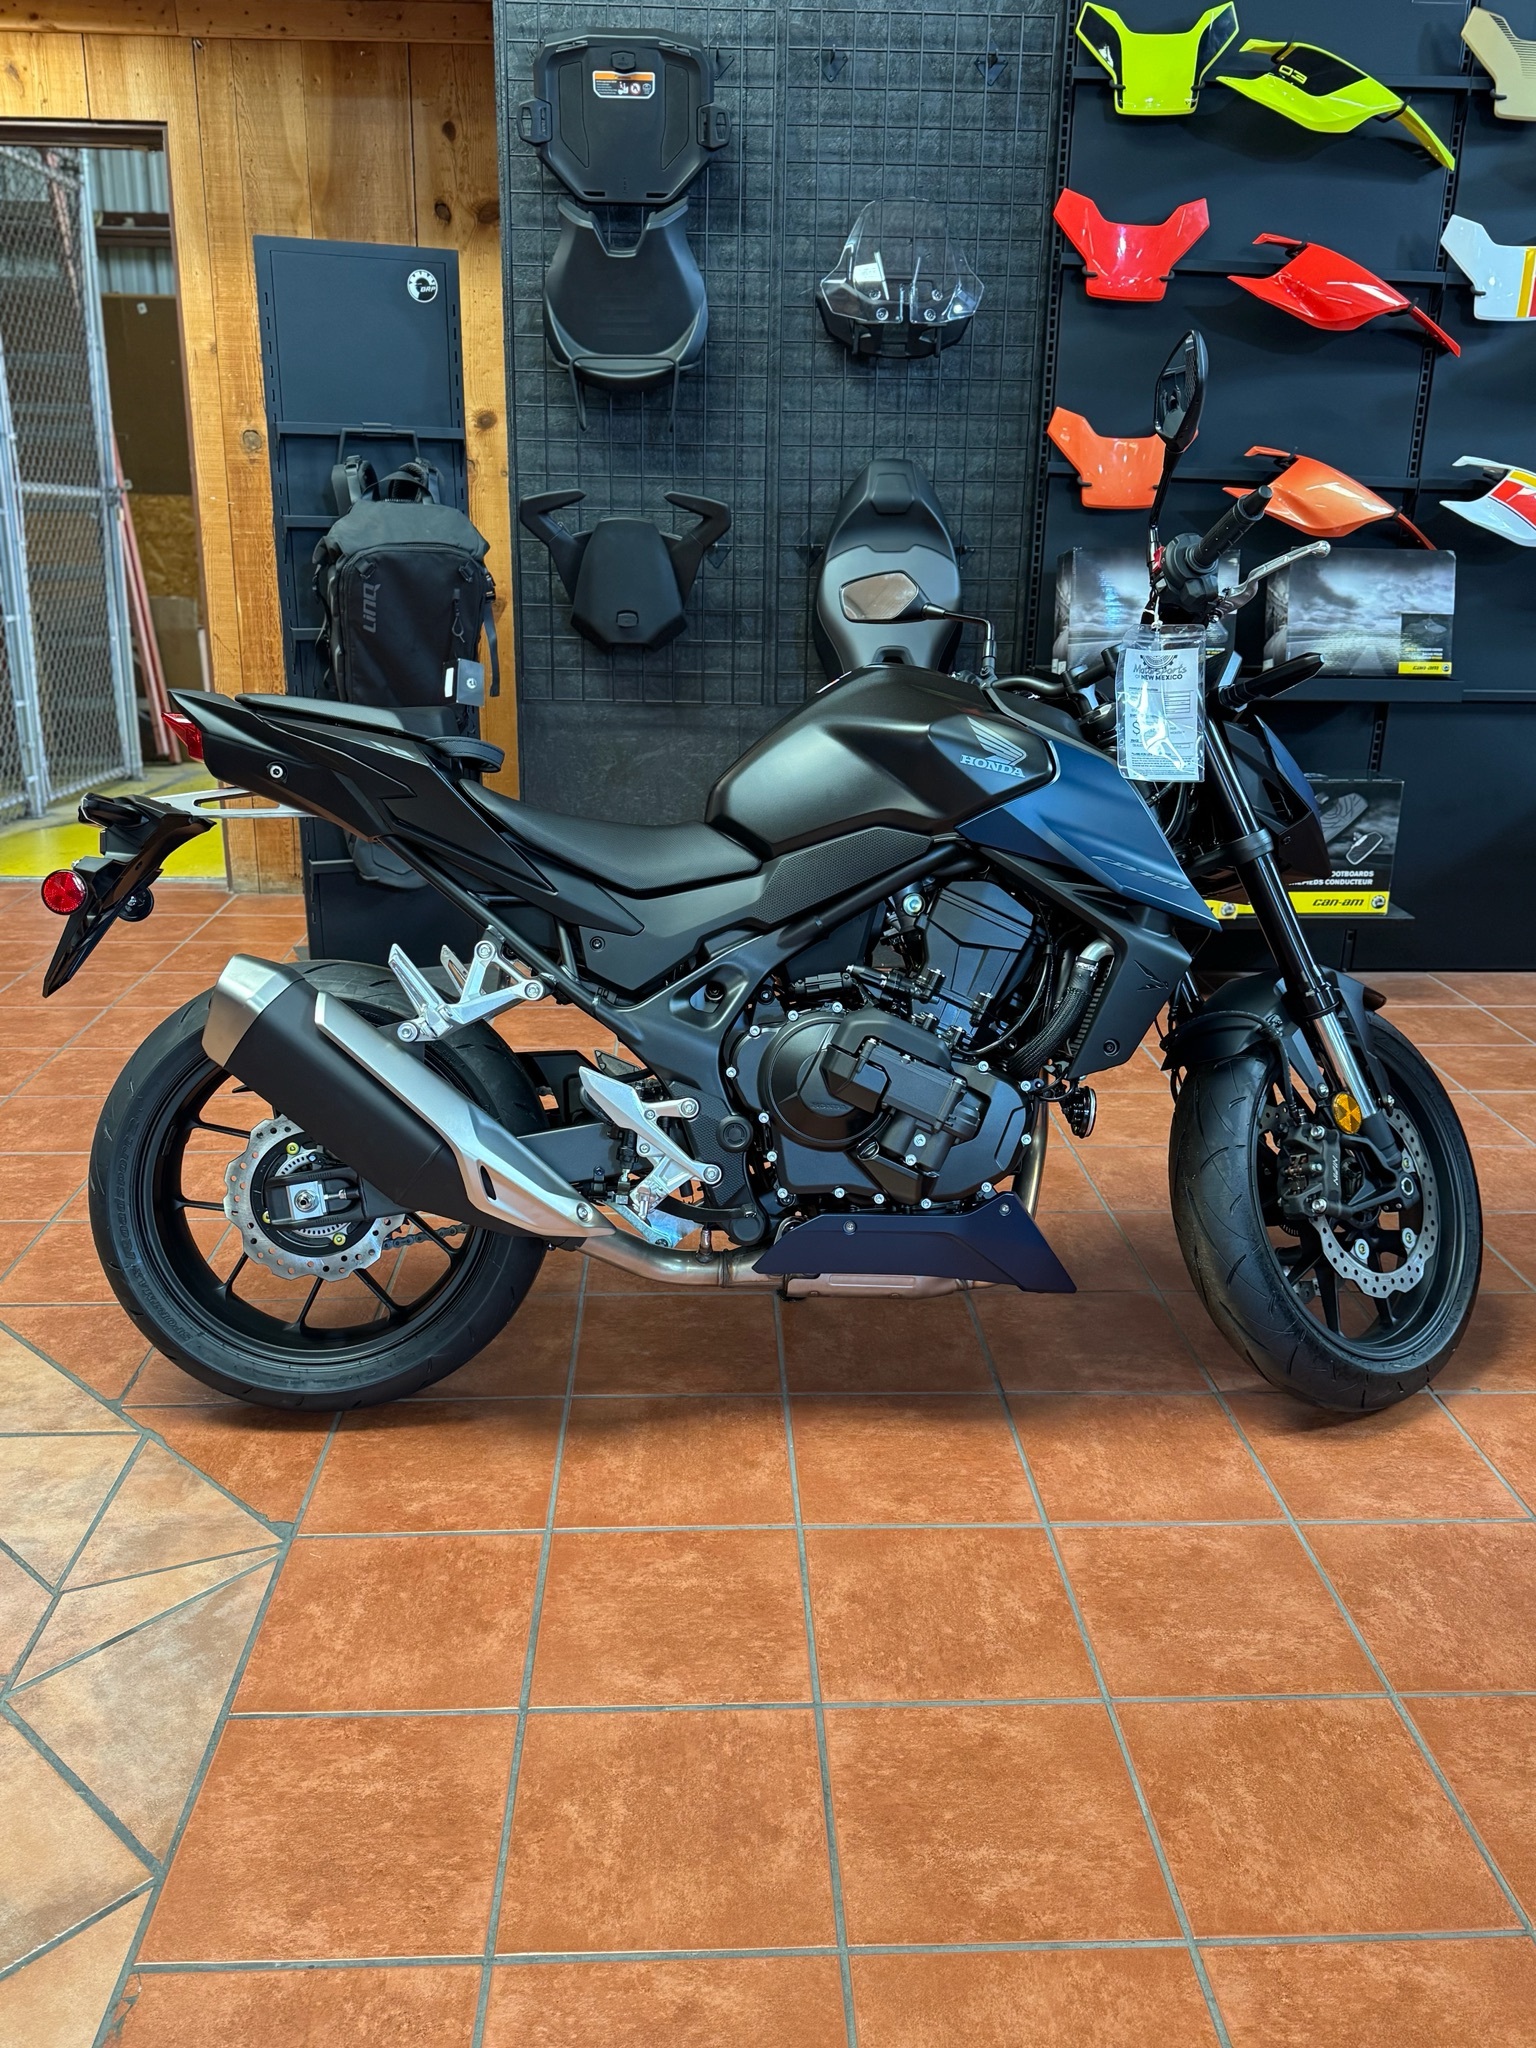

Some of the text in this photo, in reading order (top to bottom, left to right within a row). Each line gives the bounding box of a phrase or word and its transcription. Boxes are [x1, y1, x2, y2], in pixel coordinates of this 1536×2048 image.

[1279, 65, 1308, 85] 03
[1155, 673, 1183, 681] MEXICO
[960, 755, 1026, 778] HONDA
[1325, 878, 1373, 886] CONDUCTEUR
[1312, 898, 1364, 907] can-am
